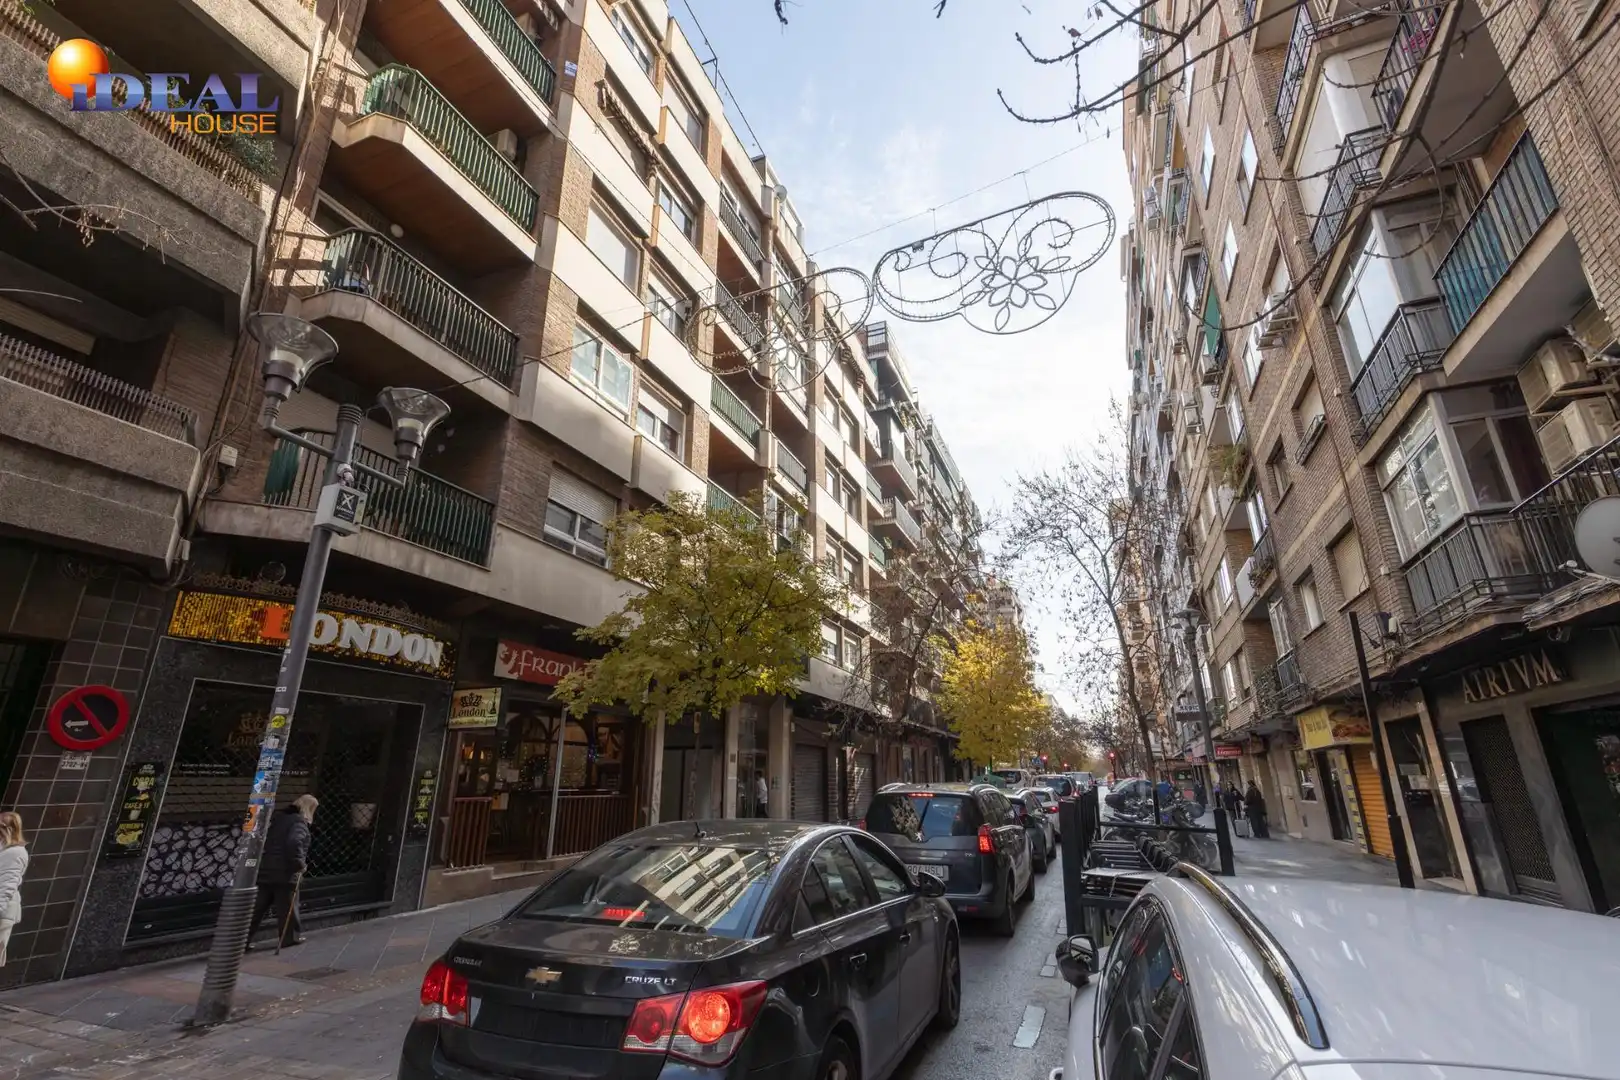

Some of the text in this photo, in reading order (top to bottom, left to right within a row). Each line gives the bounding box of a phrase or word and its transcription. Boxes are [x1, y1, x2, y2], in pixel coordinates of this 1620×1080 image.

[1462, 648, 1561, 704] ATRIVM
[452, 706, 486, 718] London
[624, 975, 661, 985] CRUZE
